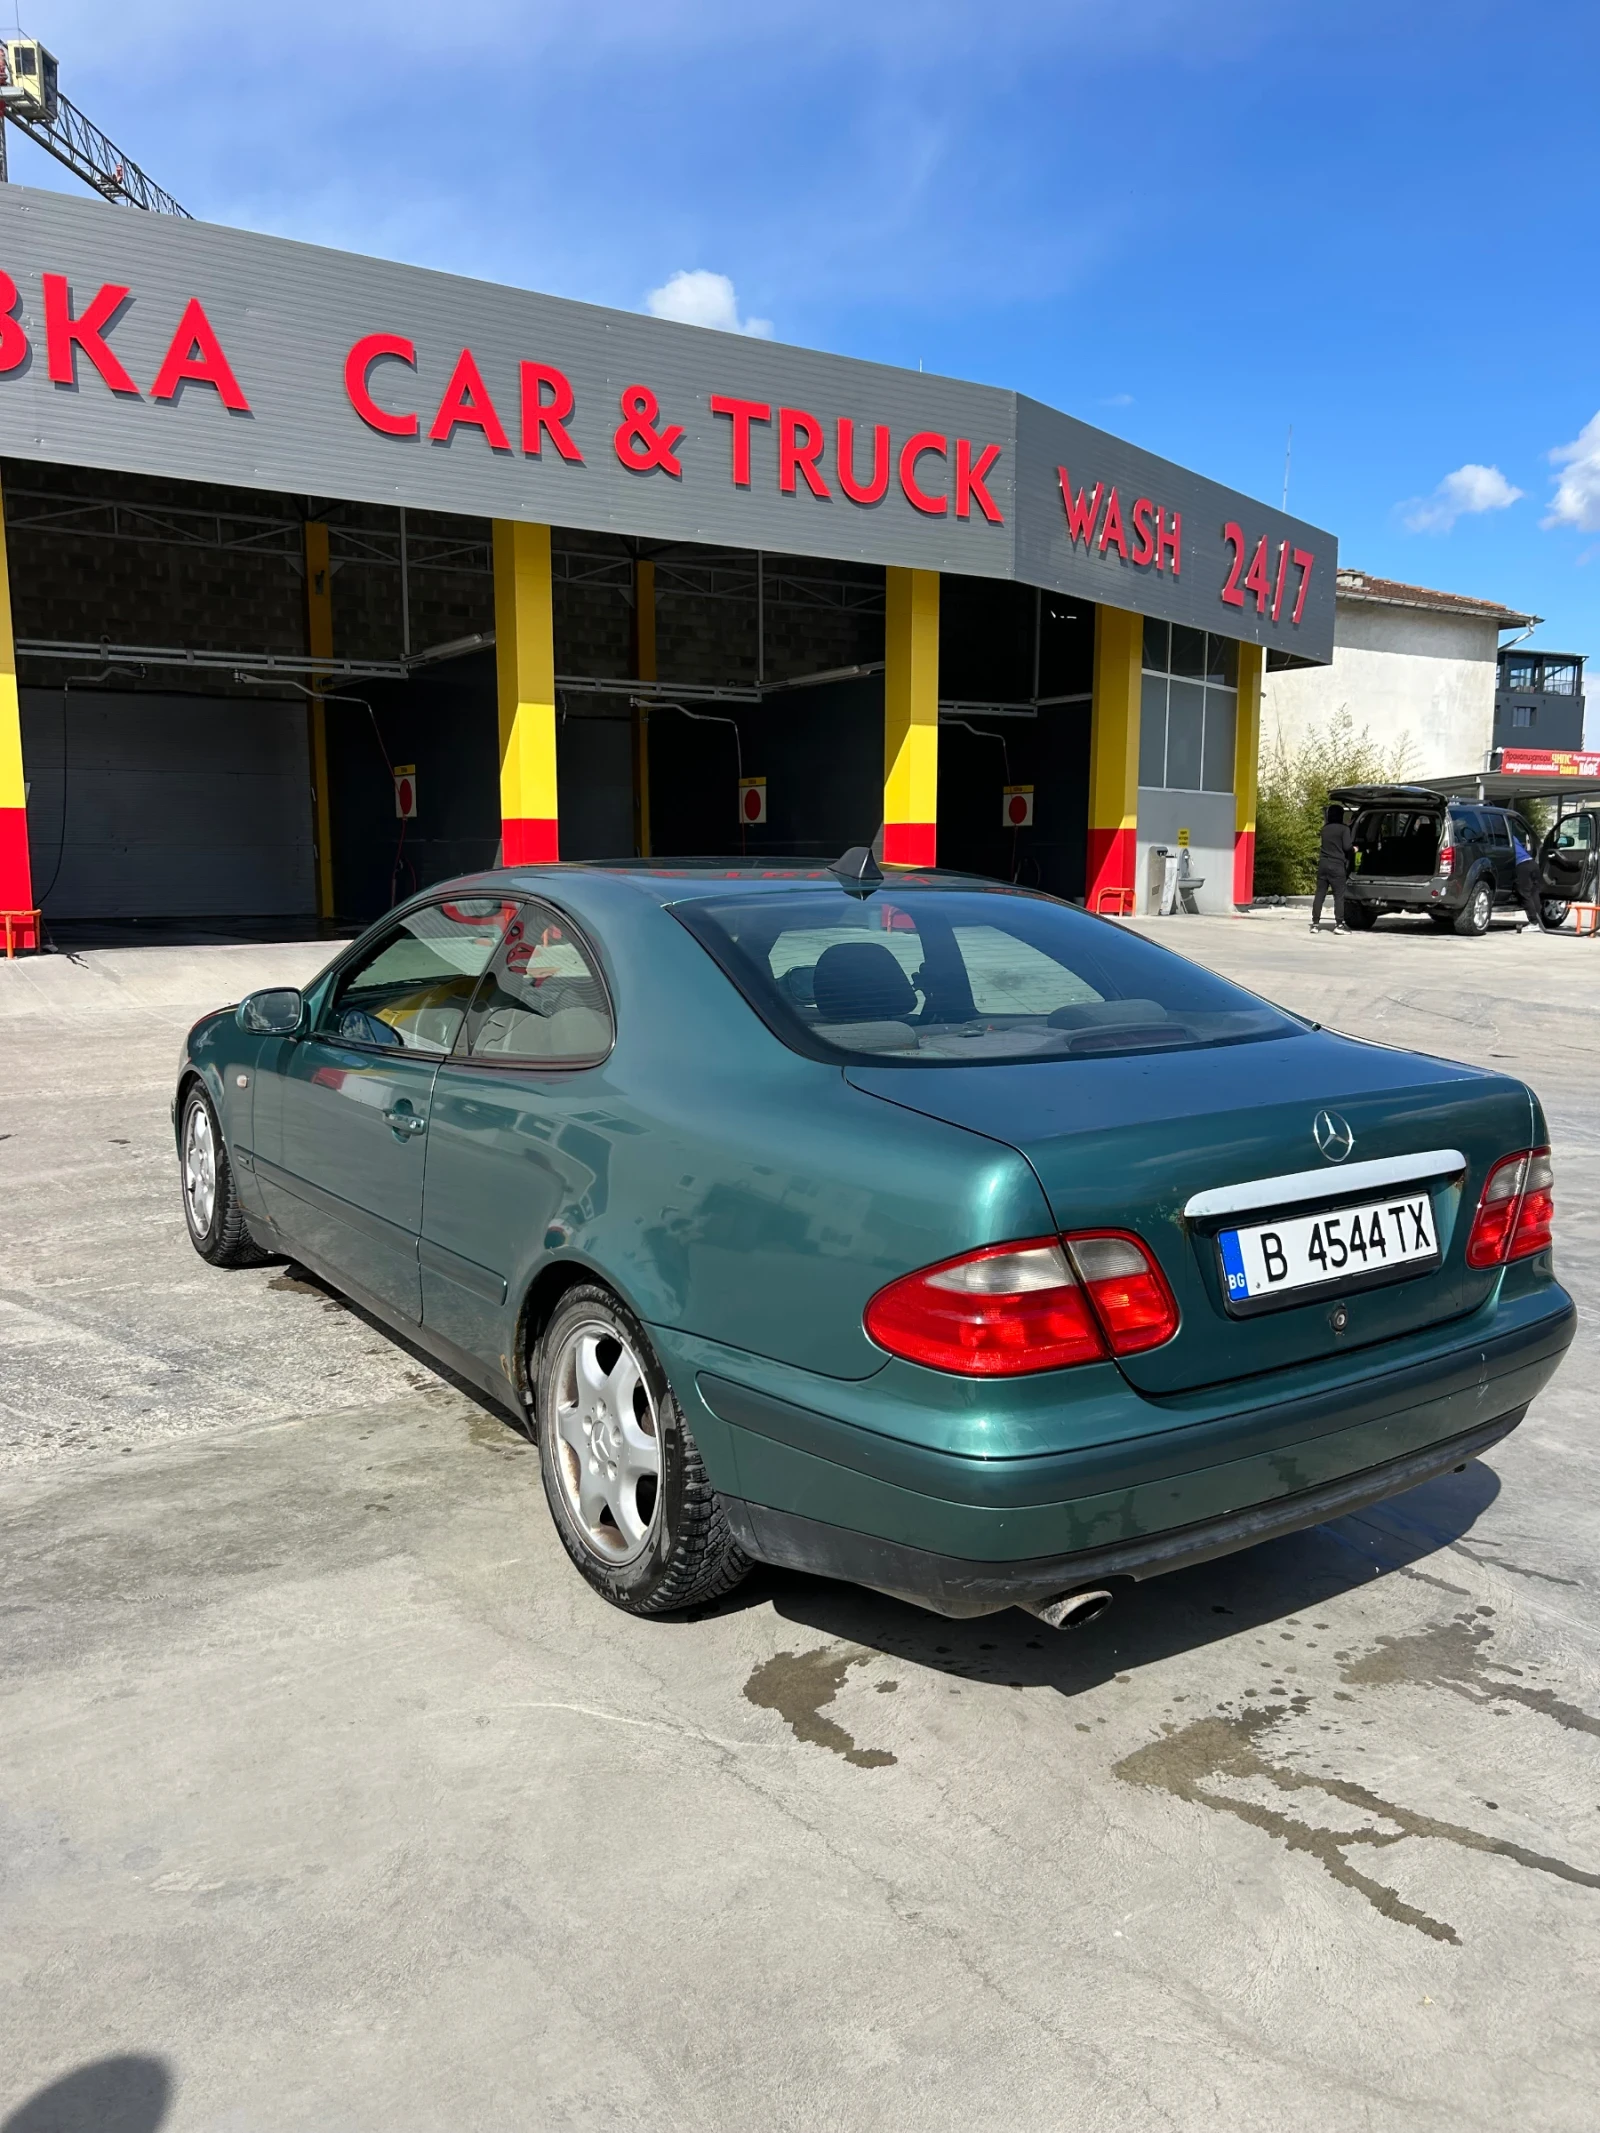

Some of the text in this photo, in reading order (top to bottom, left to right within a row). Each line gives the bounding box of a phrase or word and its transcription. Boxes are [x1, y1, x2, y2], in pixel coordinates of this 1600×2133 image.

[344, 333, 1314, 623] CAR & TRUCK WASH 24/7
[1228, 1272, 1245, 1290] BG
[1260, 1232, 1288, 1283] B
